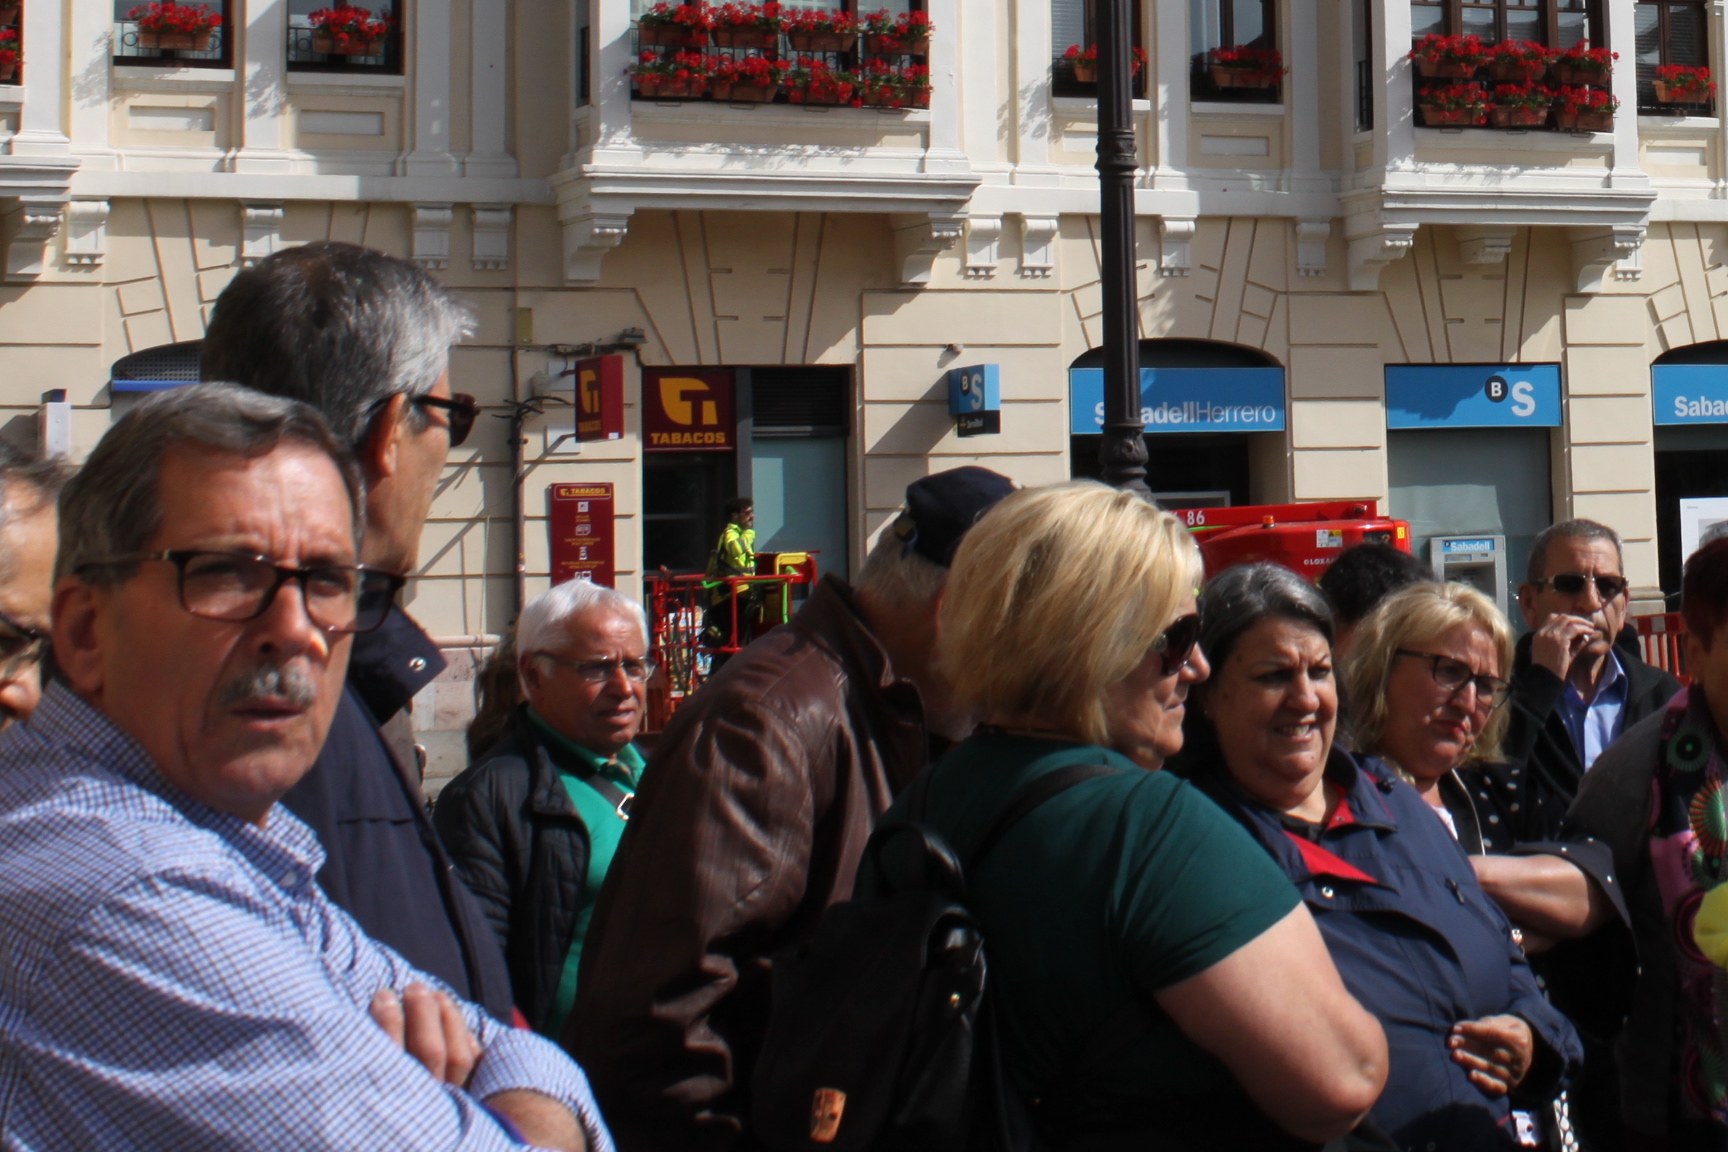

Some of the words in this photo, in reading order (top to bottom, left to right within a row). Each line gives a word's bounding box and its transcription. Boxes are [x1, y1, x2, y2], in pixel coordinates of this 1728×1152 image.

[1094, 401, 1276, 424] SadellHerrero
[651, 431, 726, 445] TABACOS
[570, 487, 606, 495] TABACOS
[1186, 510, 1205, 526] 86
[1450, 540, 1491, 551] Sabadell
